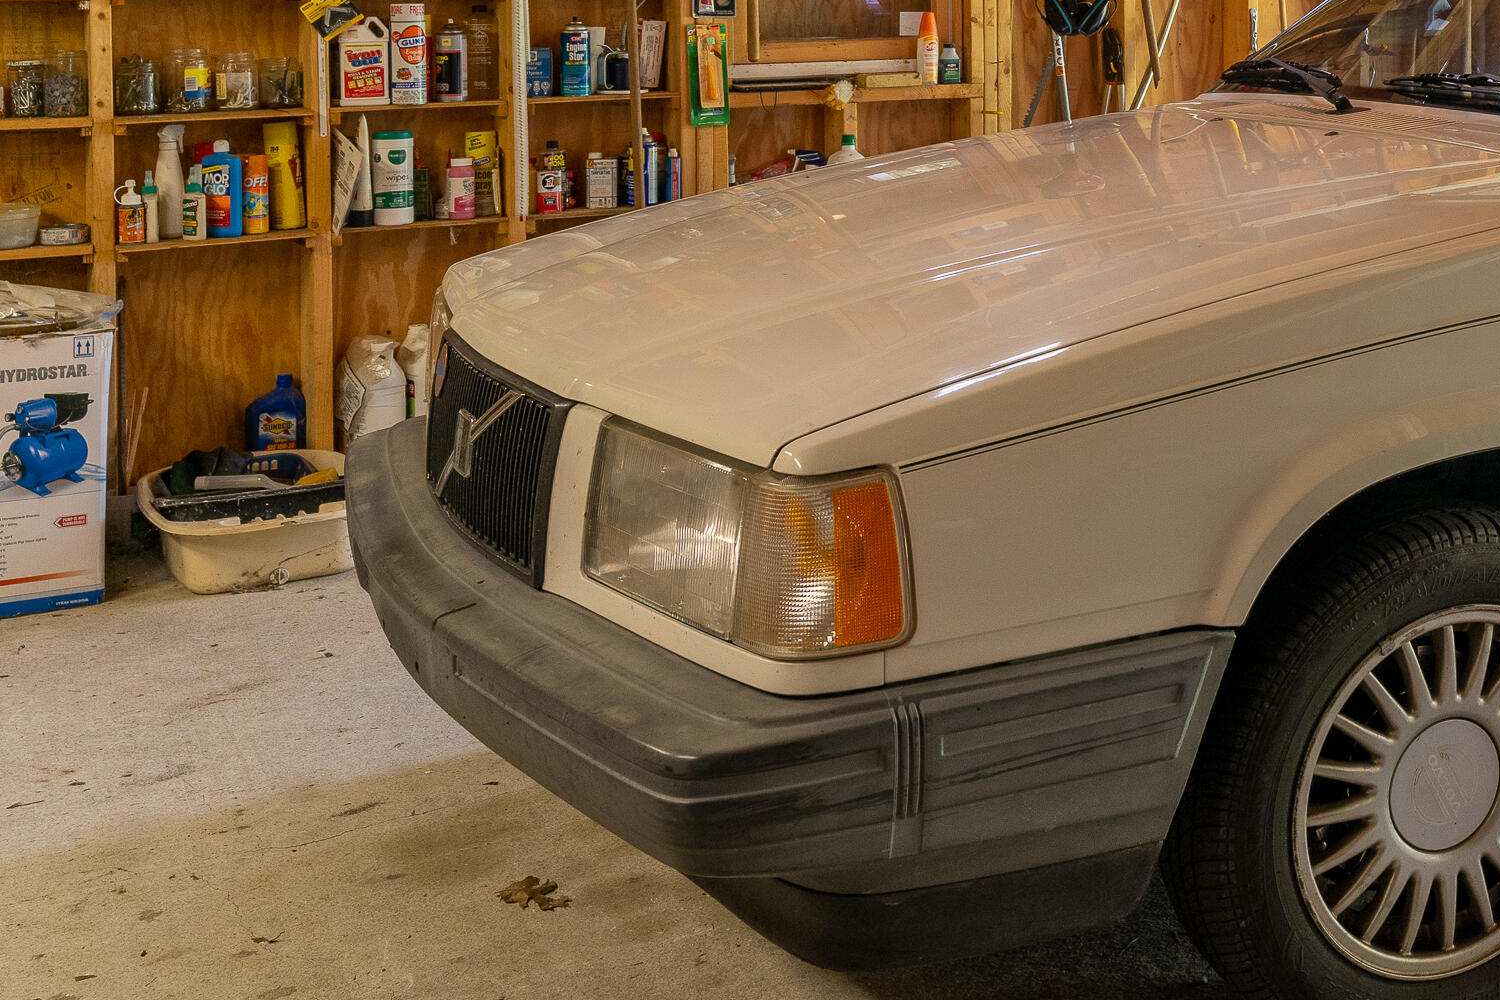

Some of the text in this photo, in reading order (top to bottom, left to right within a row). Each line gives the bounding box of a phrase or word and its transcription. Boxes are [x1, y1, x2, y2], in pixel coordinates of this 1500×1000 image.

[566, 42, 588, 53] Engine
[569, 52, 585, 62] Stor
[204, 172, 229, 185] MOP
[243, 175, 268, 188] OFF!
[203, 183, 227, 196] GLO
